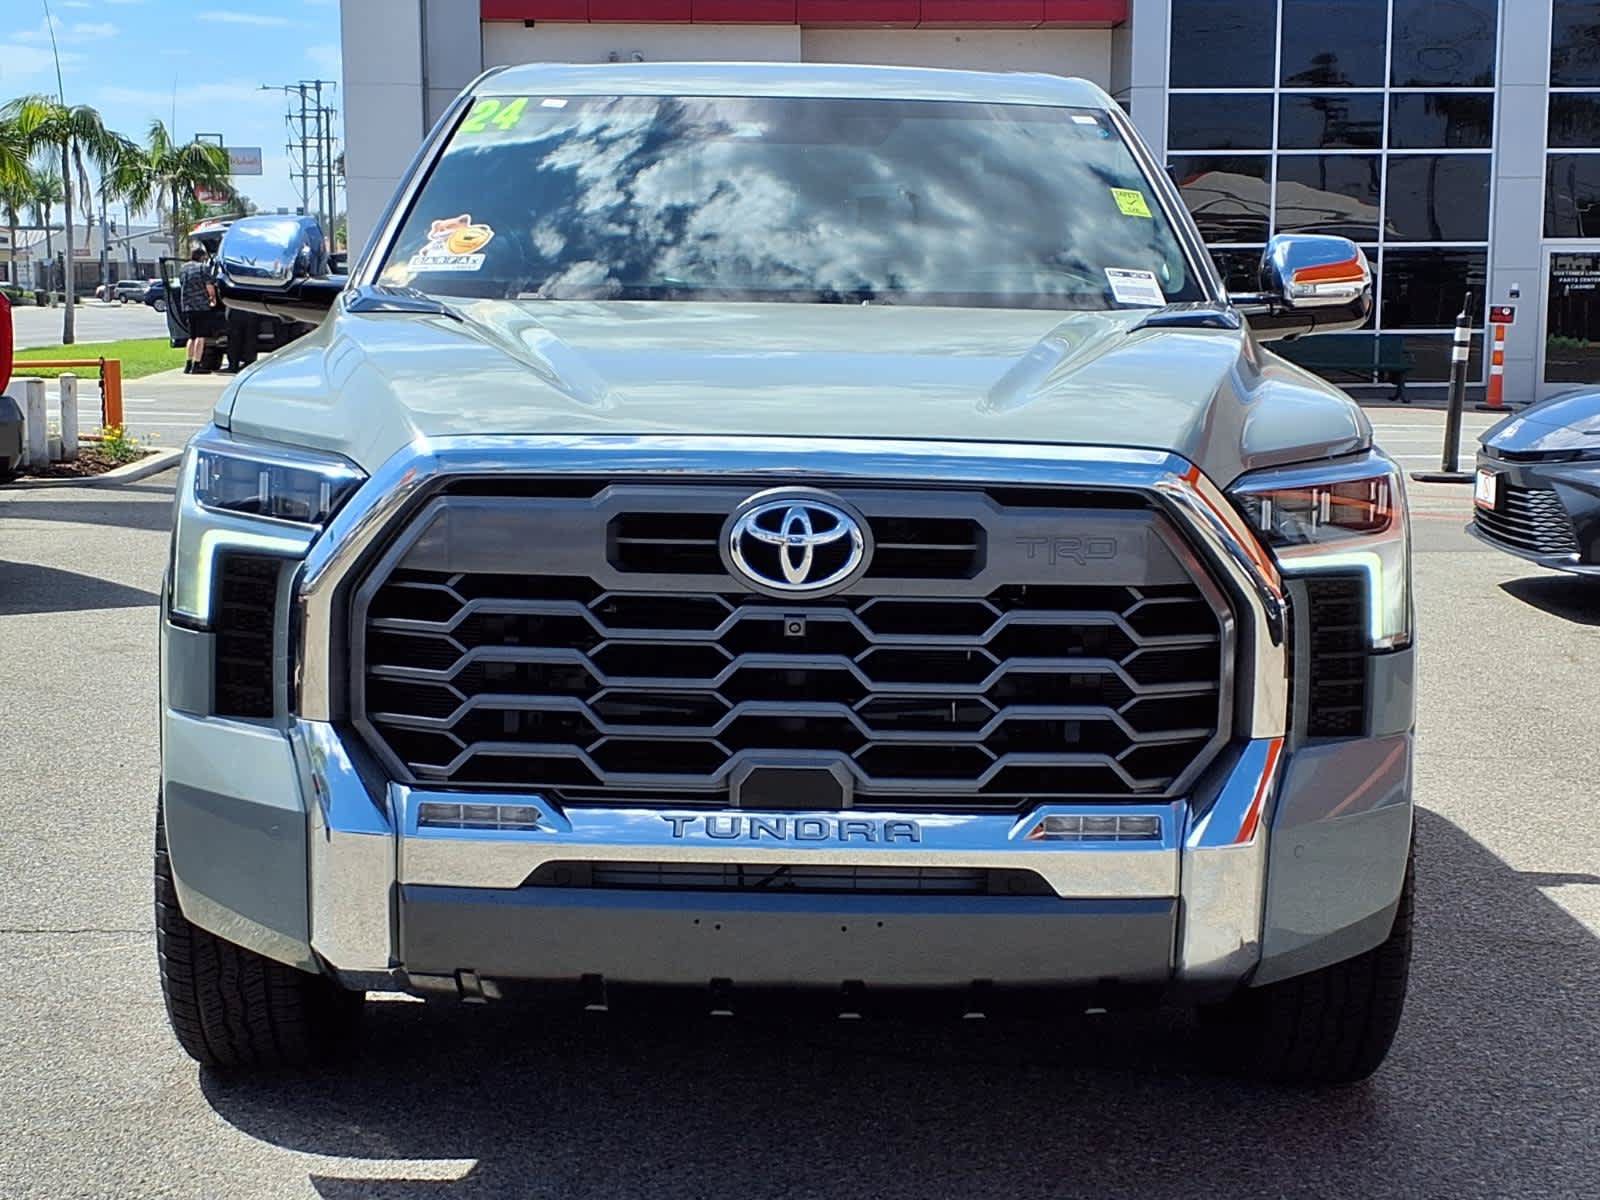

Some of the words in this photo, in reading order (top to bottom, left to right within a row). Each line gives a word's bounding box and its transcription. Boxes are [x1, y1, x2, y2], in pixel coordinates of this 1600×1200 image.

[460, 96, 529, 133] 24
[1016, 536, 1118, 566] TRD
[661, 815, 921, 843] TUNDRA
